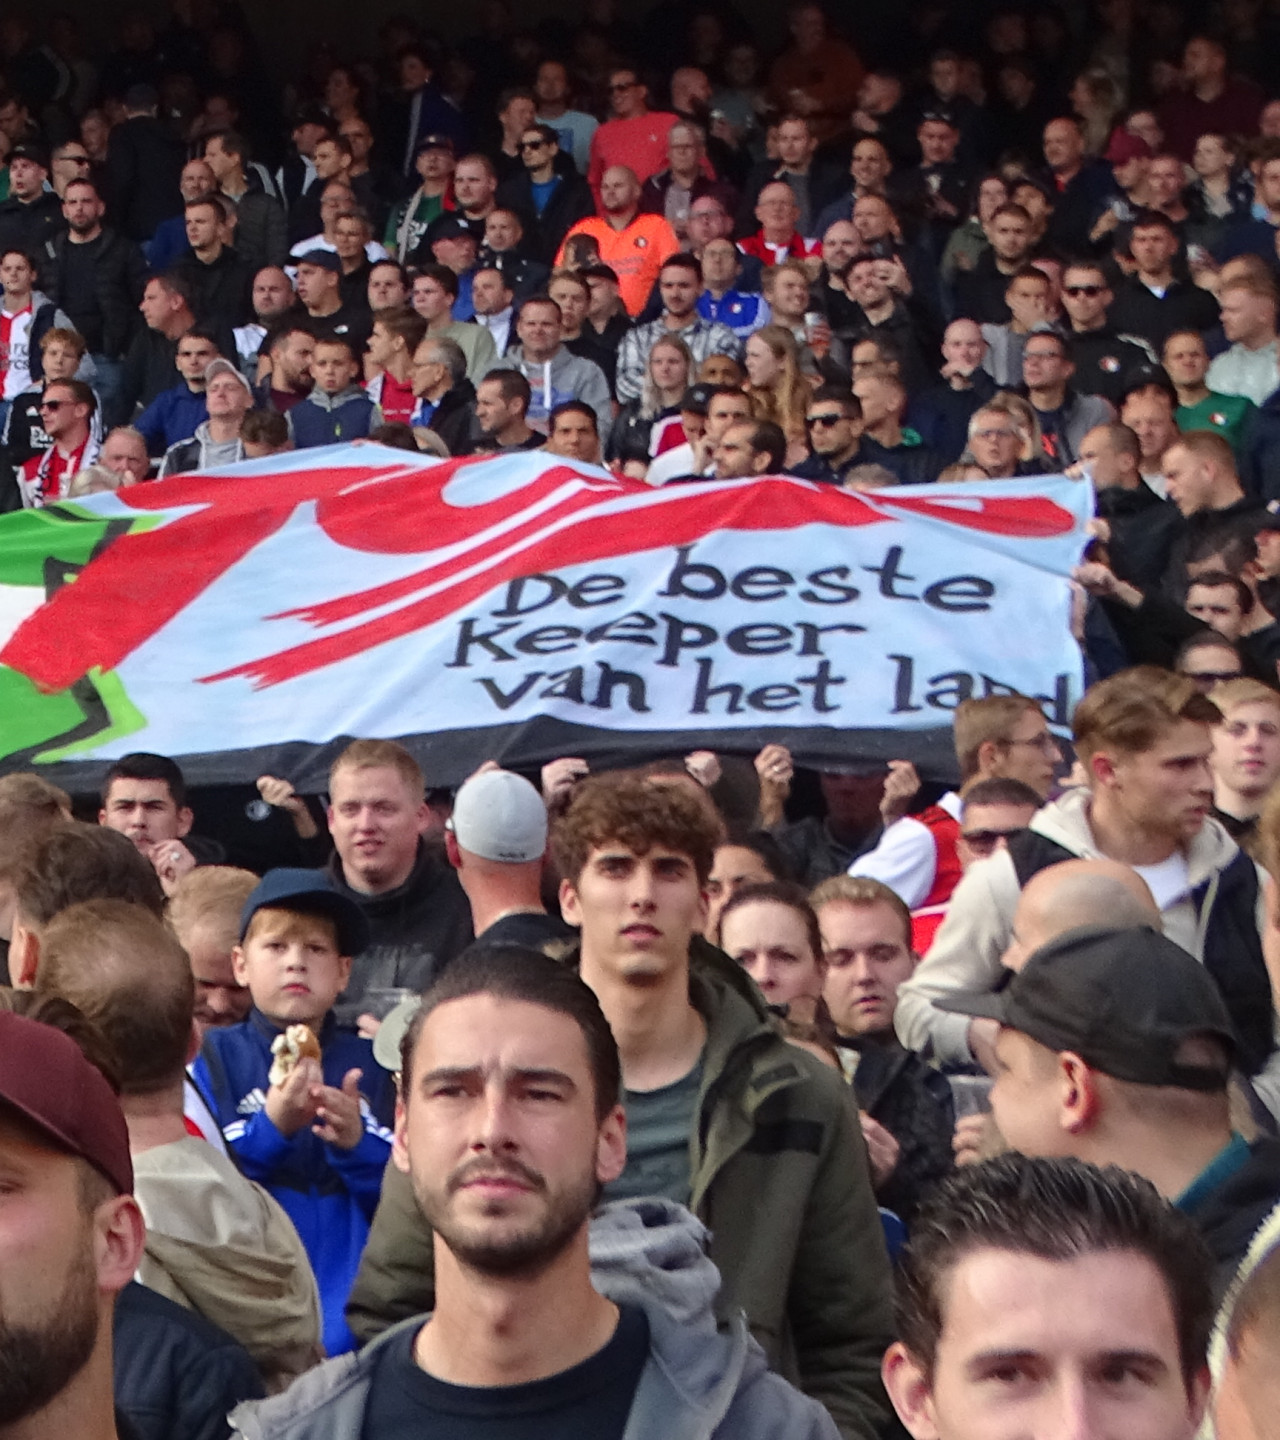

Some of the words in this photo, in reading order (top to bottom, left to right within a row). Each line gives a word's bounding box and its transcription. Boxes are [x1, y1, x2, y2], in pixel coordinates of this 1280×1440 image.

[489, 572, 626, 618] De
[657, 544, 996, 613] beste
[444, 610, 867, 667] Keeper
[473, 660, 652, 714] van
[689, 656, 848, 715] het
